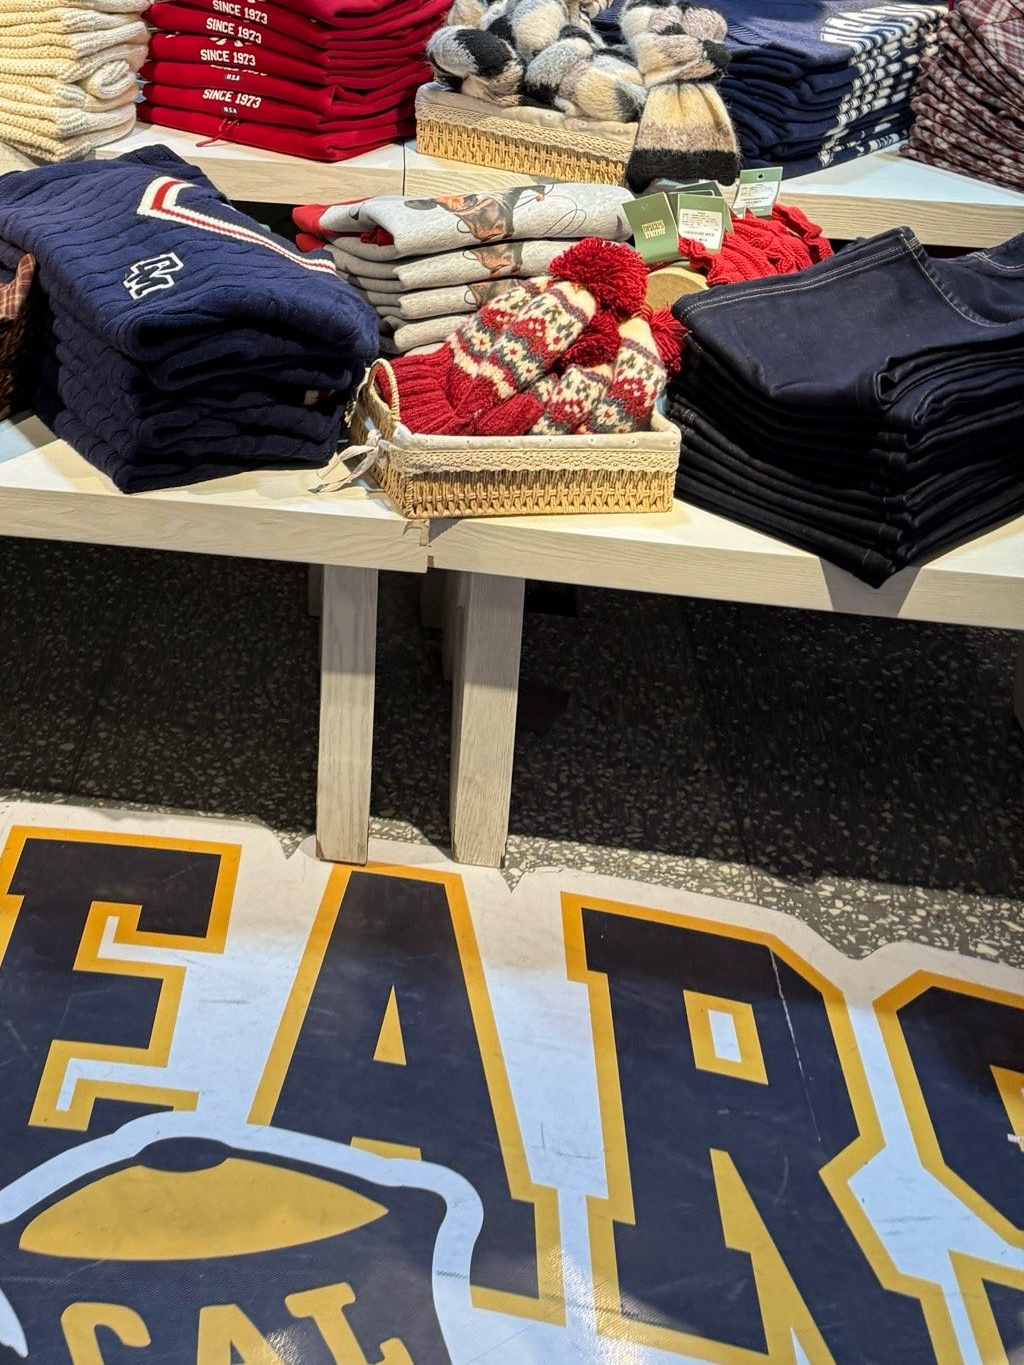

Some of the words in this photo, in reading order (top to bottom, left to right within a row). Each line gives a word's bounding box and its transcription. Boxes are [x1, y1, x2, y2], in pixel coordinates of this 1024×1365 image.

[212, 0, 241, 17] SINCE
[244, 7, 268, 25] 1973
[206, 17, 234, 35] SINCE
[237, 26, 262, 44] 1973
[200, 49, 230, 62] SINCE
[233, 52, 256, 66] 1973
[202, 89, 234, 102] SINCE
[235, 93, 262, 109] 1973
